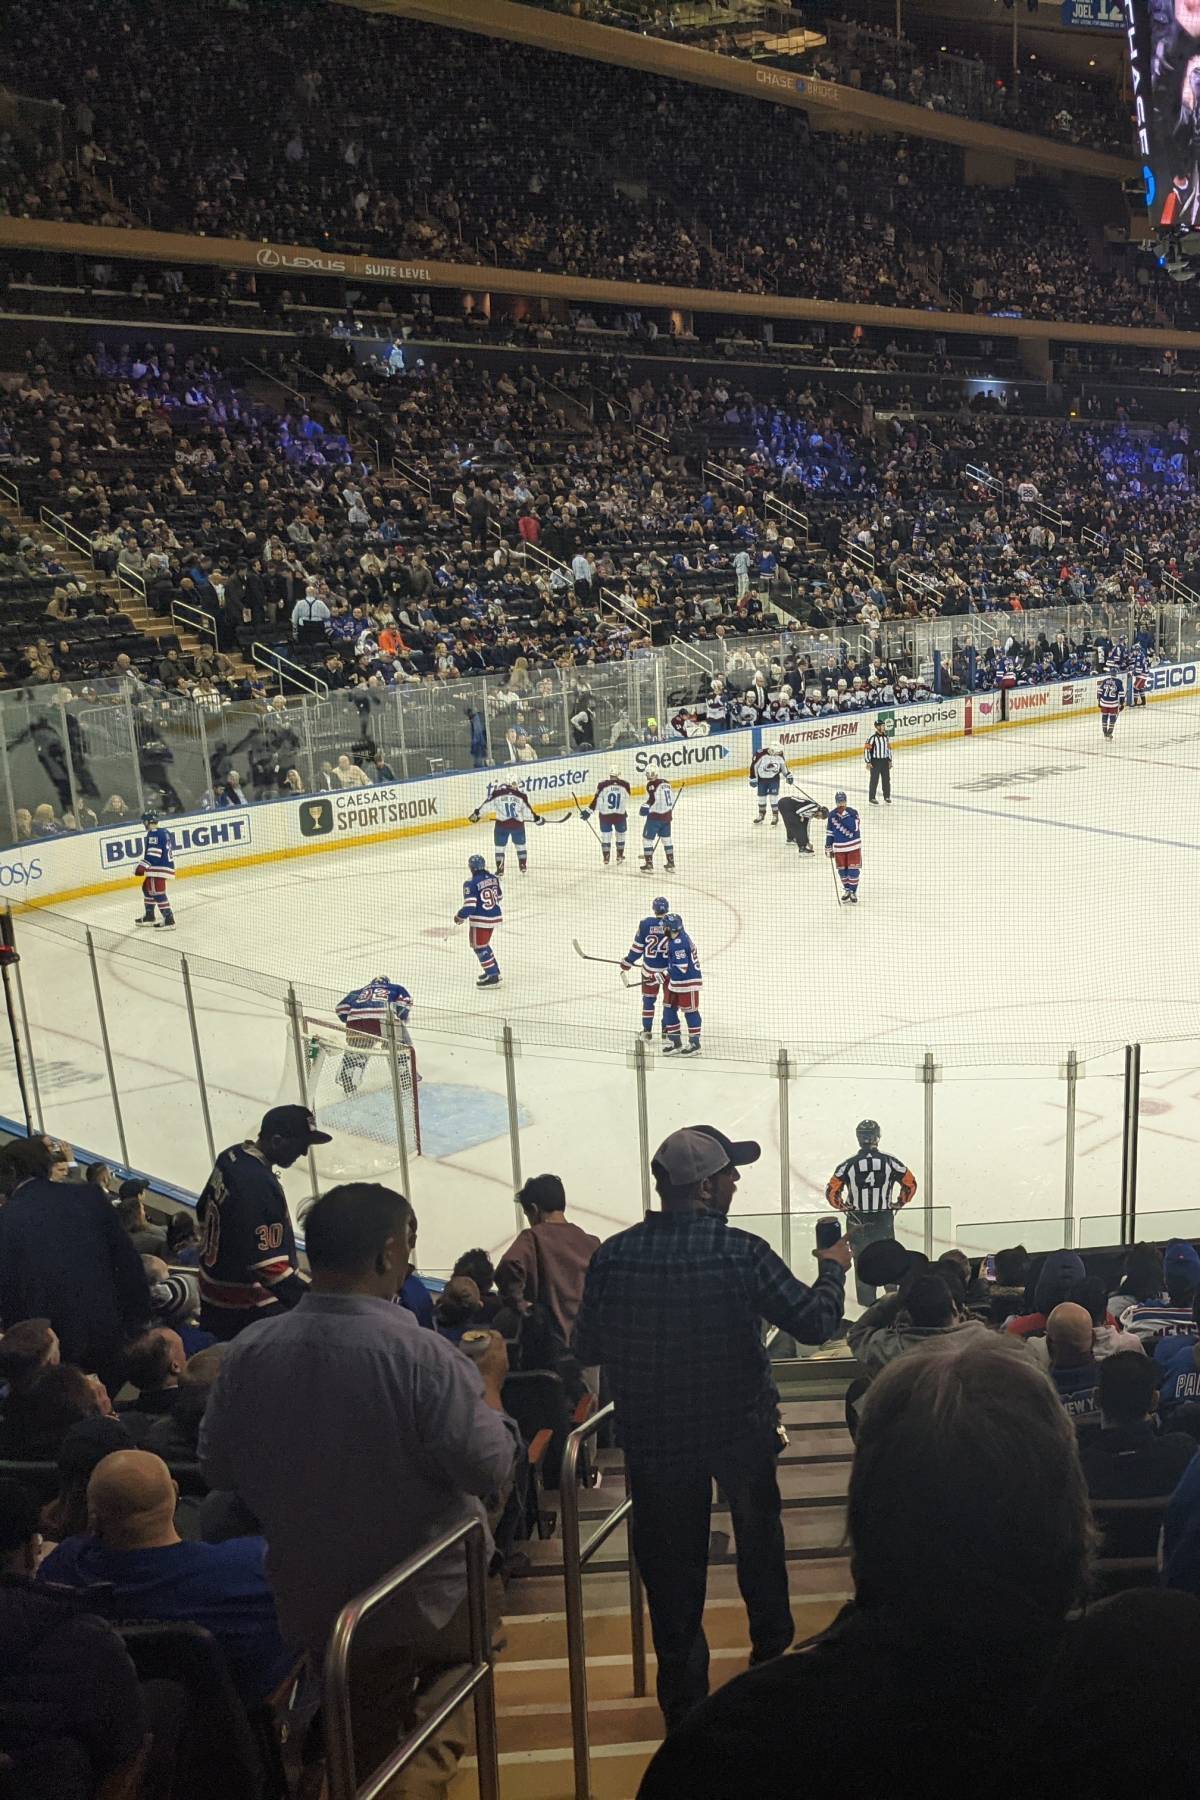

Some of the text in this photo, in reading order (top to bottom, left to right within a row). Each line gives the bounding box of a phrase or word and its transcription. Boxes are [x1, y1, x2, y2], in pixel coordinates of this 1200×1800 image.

[1072, 4, 1094, 19] JOEL
[756, 71, 839, 101] CHASE BRIDGE
[282, 255, 345, 272] LEXUS
[366, 264, 431, 280] SUITE LEVEL
[1145, 666, 1196, 690] GEICO
[635, 744, 723, 772] Spectrum
[336, 788, 397, 809] CAESARS
[608, 792, 620, 809] 91
[337, 797, 438, 831] SPORTSBOOK
[106, 821, 245, 862] BU LIGHT
[645, 935, 669, 958] 24
[865, 1171, 875, 1187] 4
[256, 1222, 283, 1251] 30
